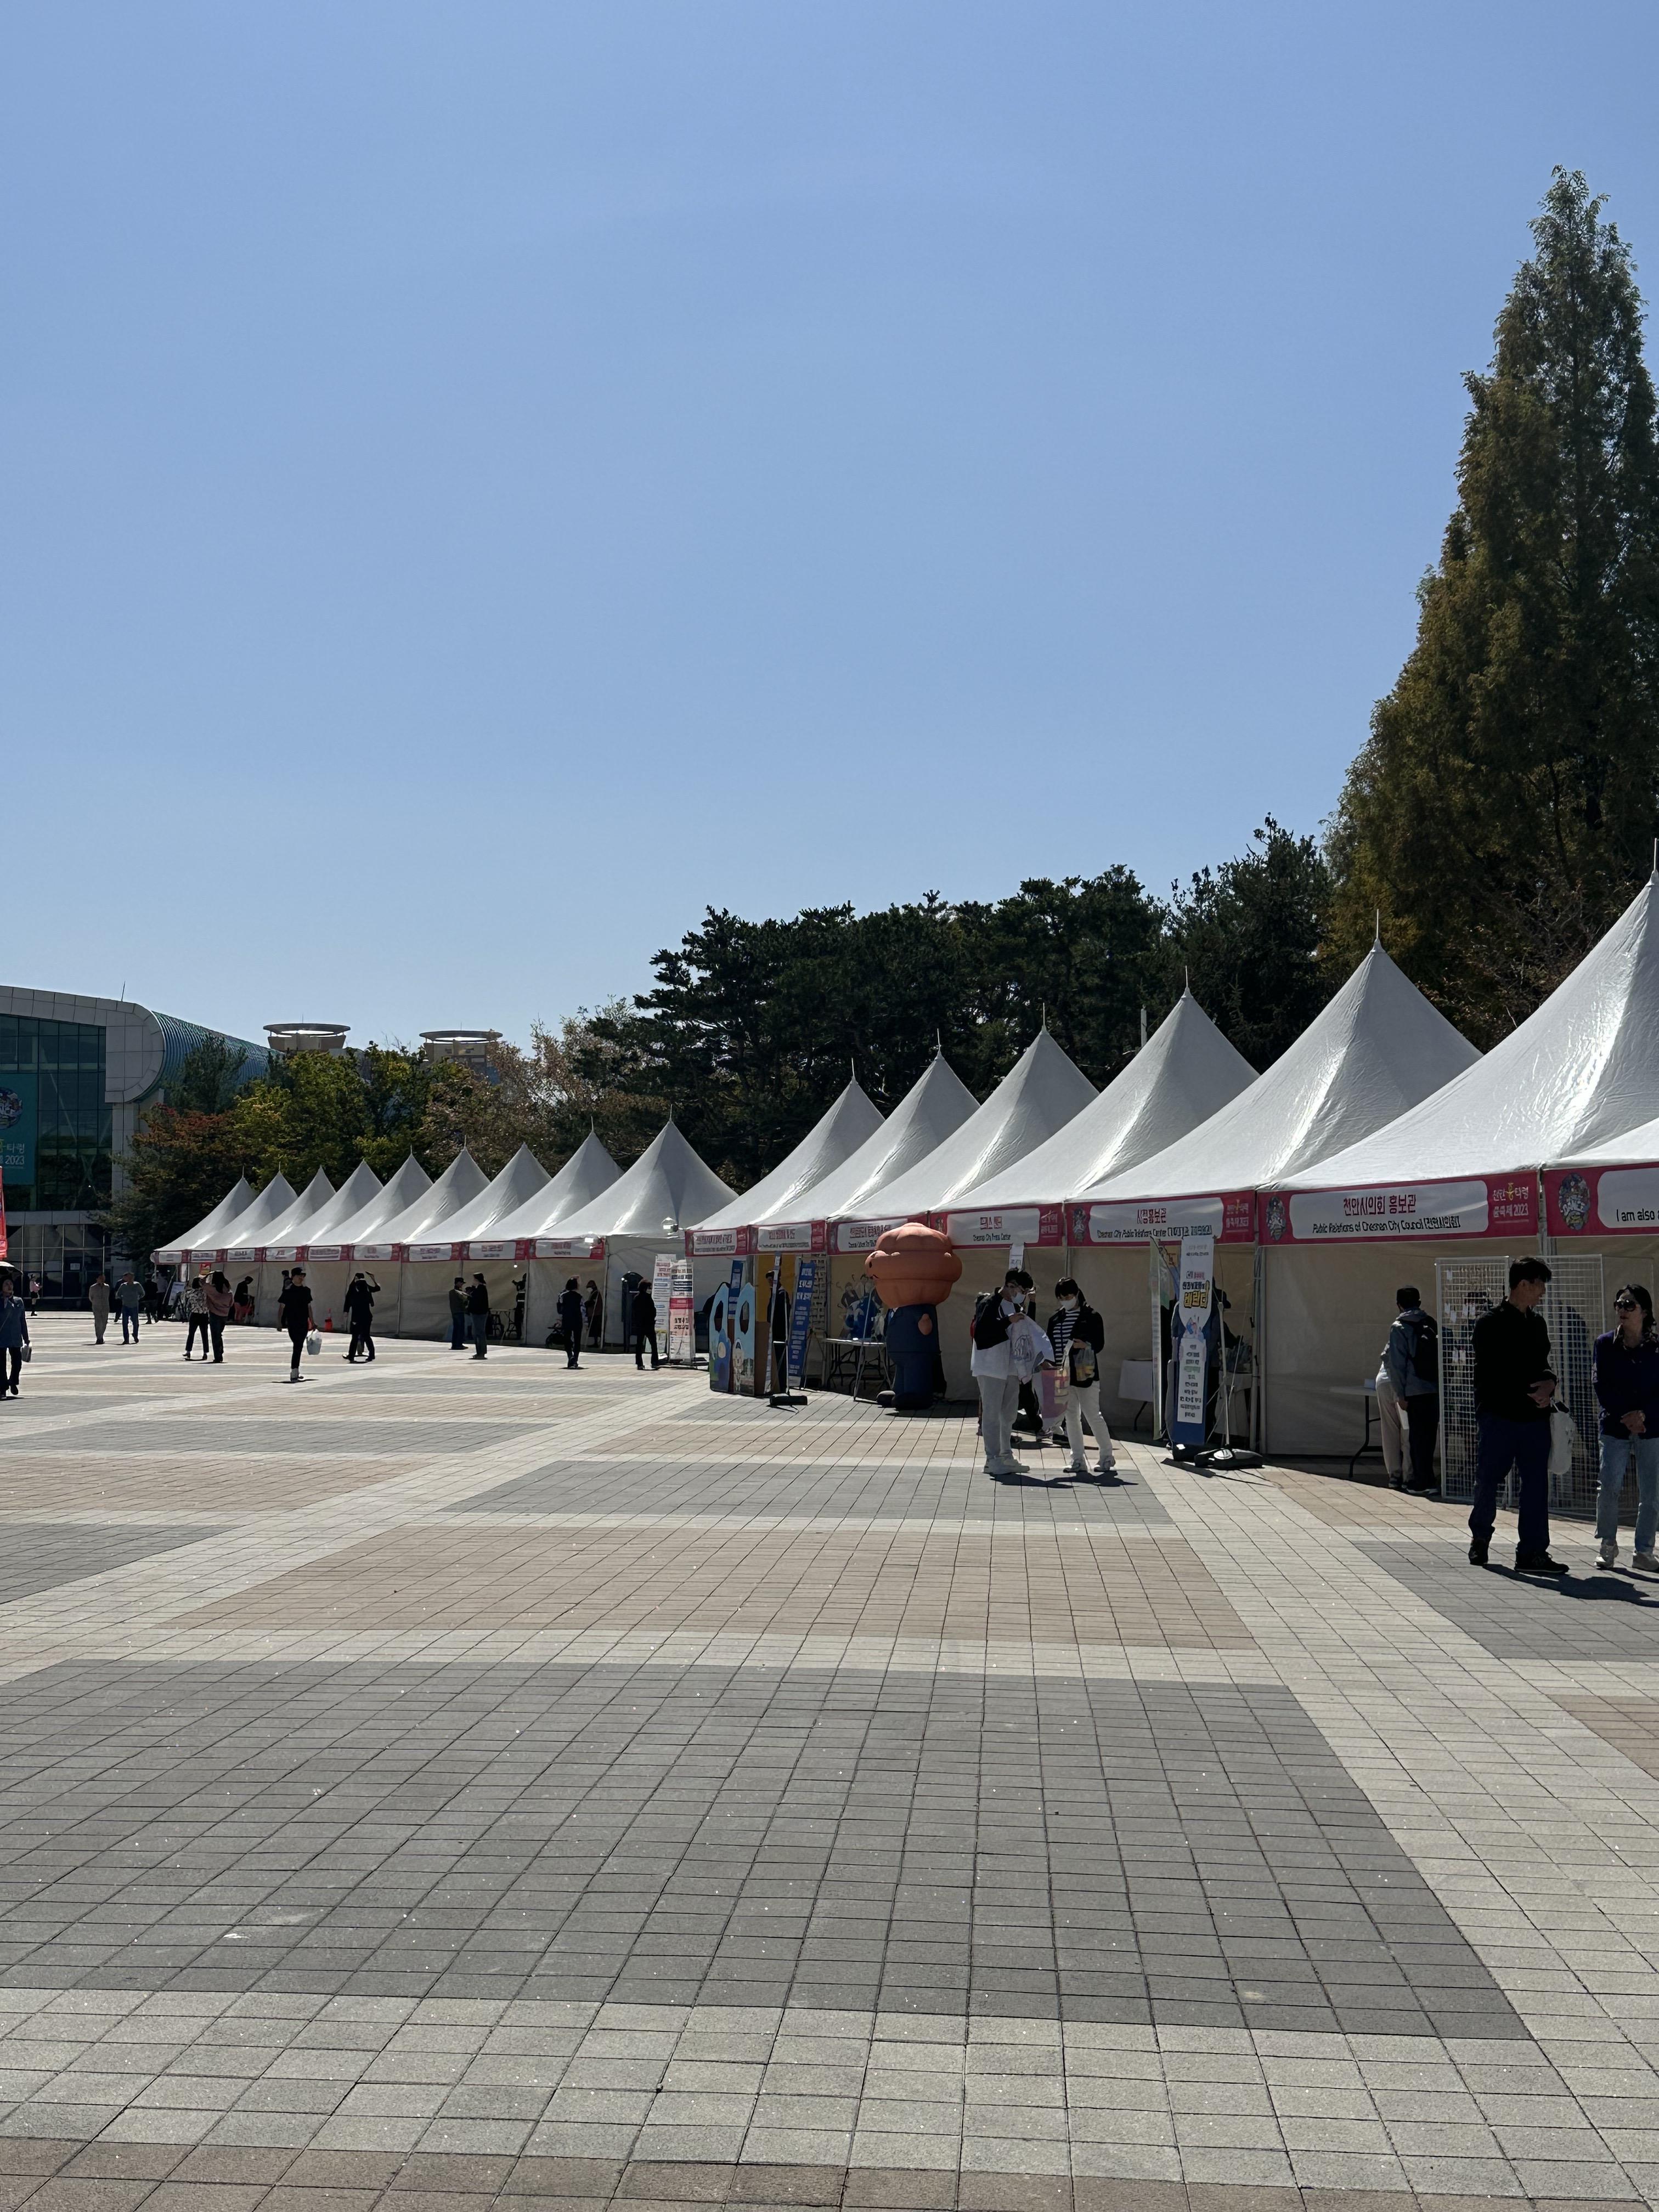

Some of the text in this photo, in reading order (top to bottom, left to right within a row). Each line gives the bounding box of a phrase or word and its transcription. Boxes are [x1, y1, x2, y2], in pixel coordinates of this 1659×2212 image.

[5, 1155, 25, 1165] 2023
[1344, 1194, 1416, 1216] 천안시의회 홍보관
[1514, 1203, 1529, 1216] 2023
[1616, 1209, 1620, 1222] I
[1621, 1212, 1635, 1221] am
[1637, 1208, 1655, 1221] also
